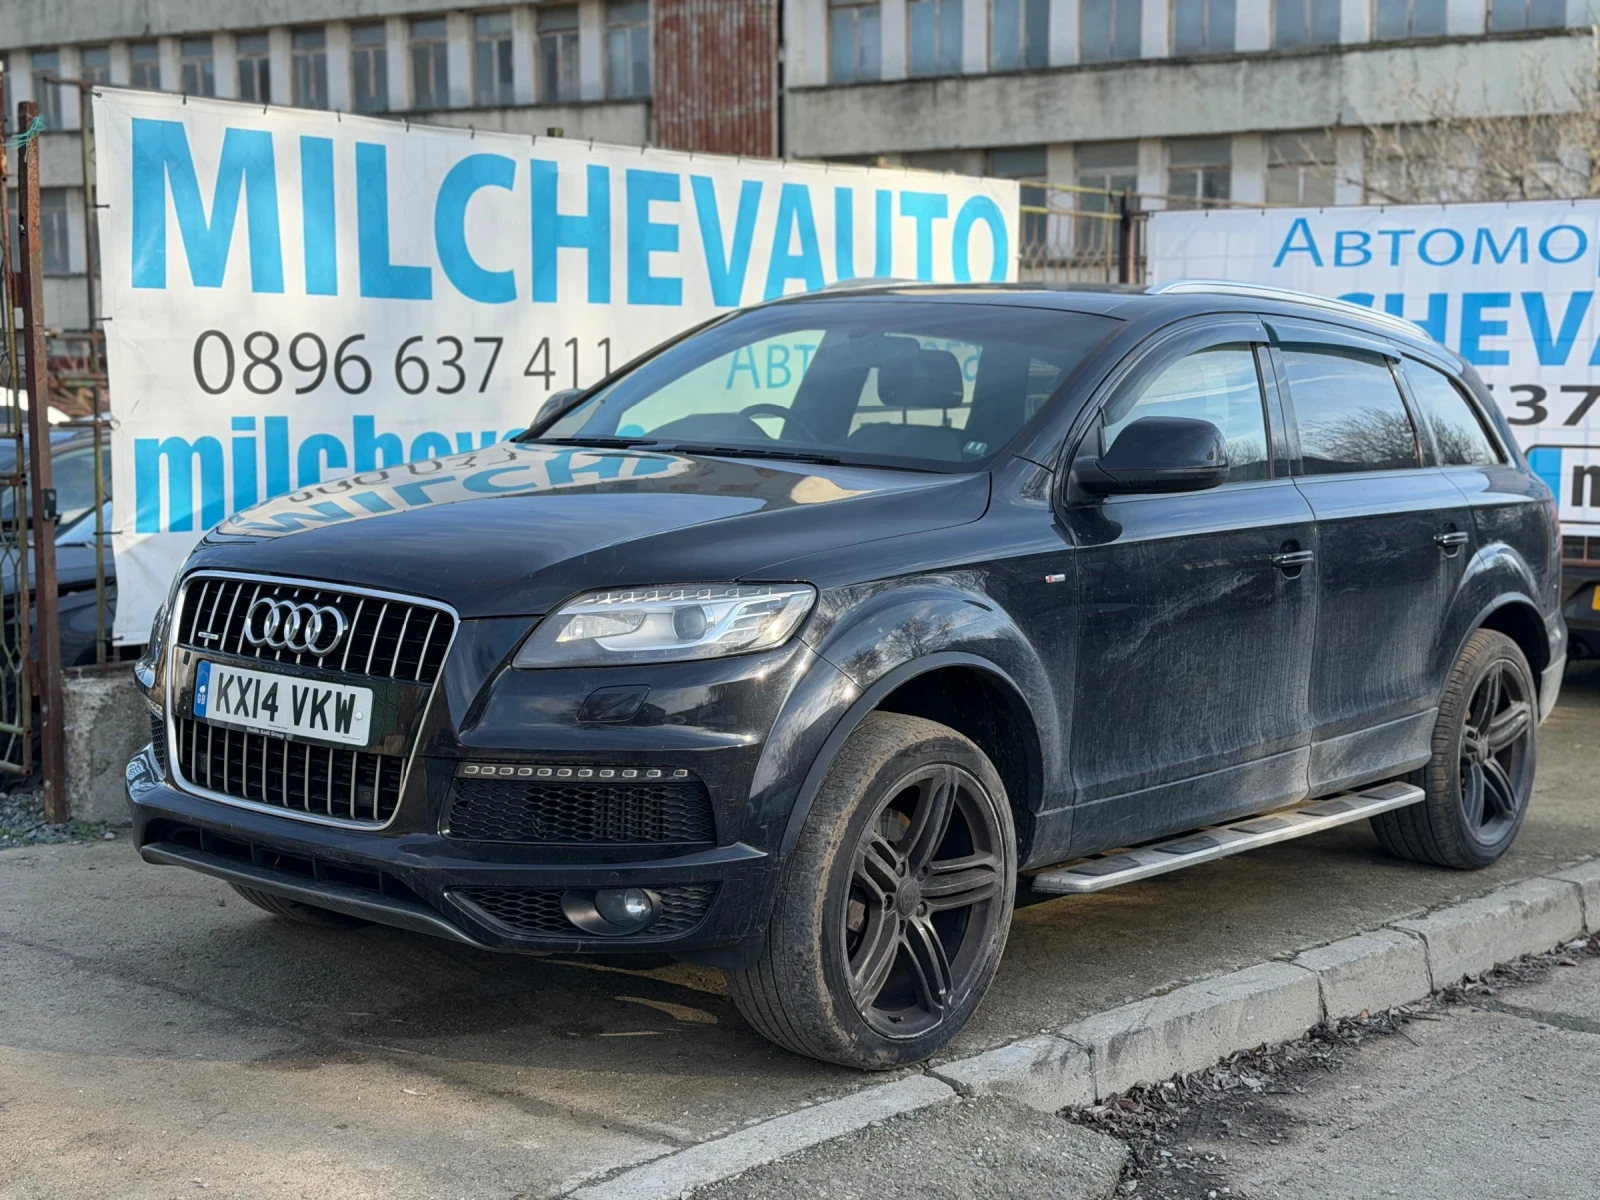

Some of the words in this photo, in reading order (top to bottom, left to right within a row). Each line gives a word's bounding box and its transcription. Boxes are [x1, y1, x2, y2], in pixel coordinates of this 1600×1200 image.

[131, 117, 1009, 307] MILCHEVAUTO
[193, 329, 373, 396] 0896
[395, 334, 505, 396] 637
[523, 336, 612, 391] 411
[1486, 383, 1600, 427] 37
[215, 672, 279, 723] KX14
[291, 684, 357, 735] VKW
[260, 729, 270, 737] Audi
[271, 730, 285, 740] Group
